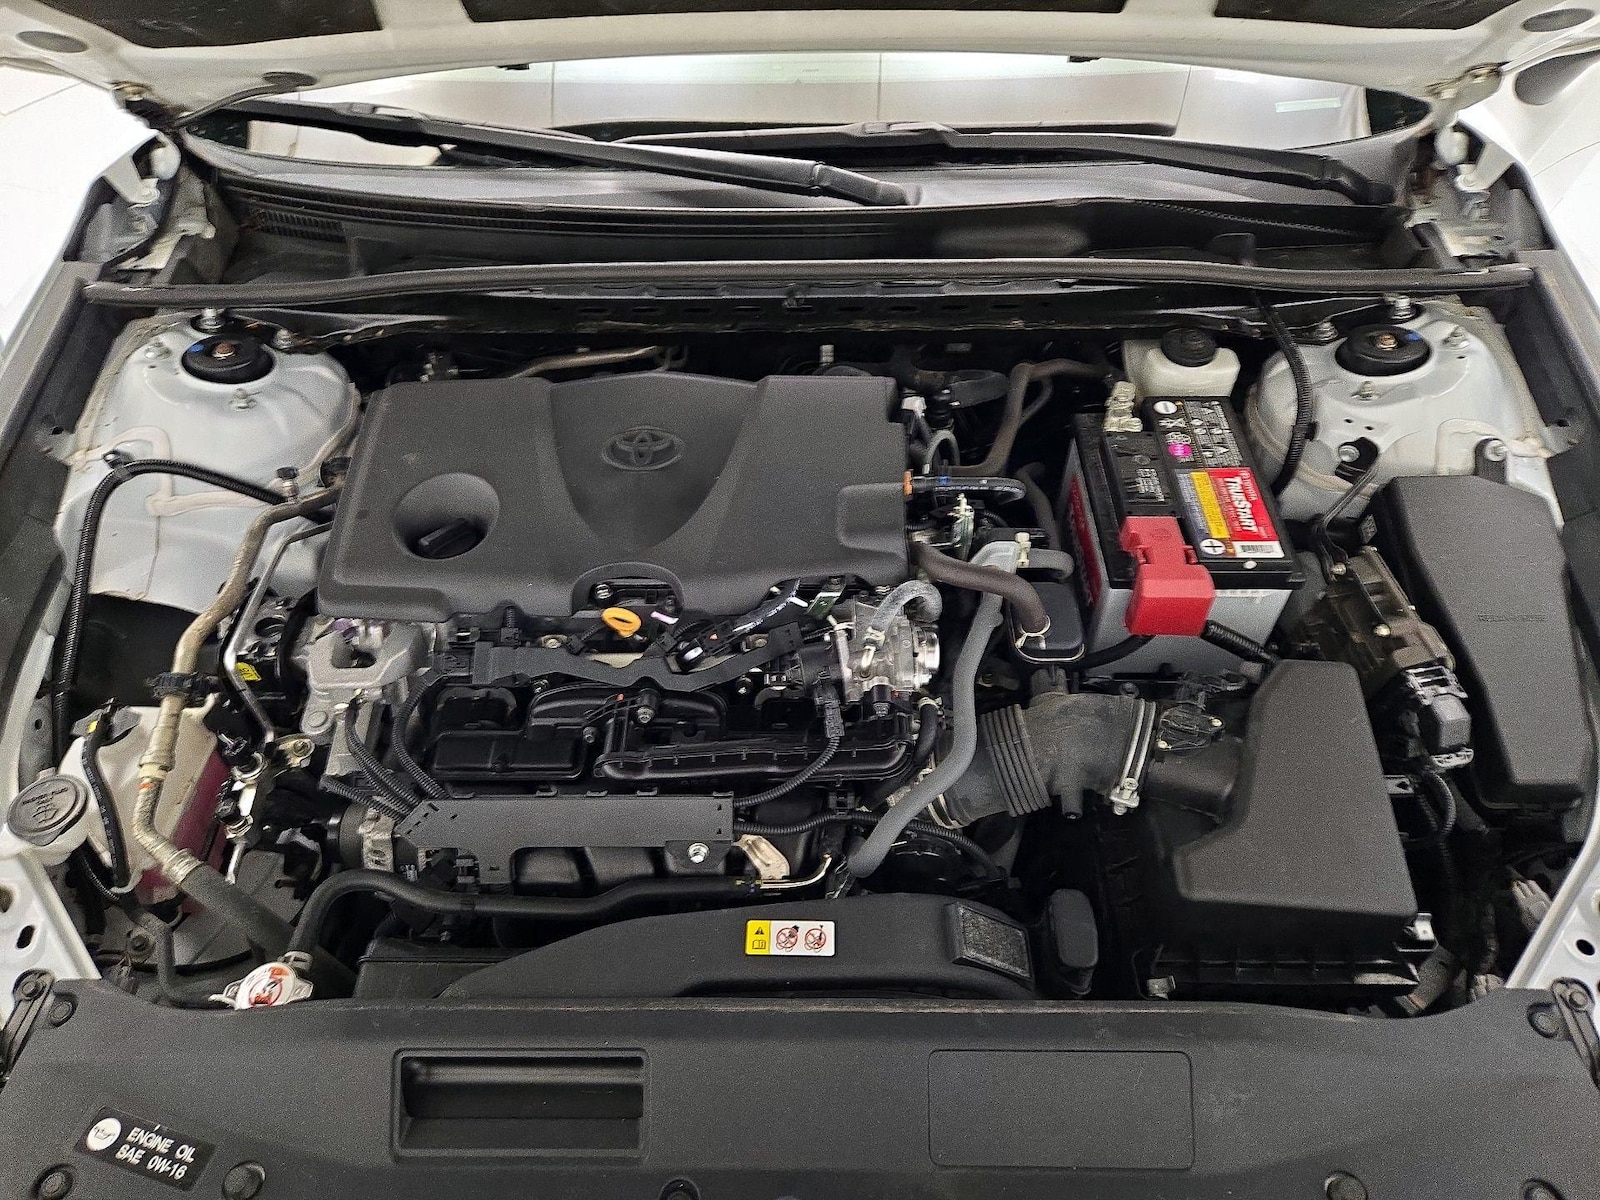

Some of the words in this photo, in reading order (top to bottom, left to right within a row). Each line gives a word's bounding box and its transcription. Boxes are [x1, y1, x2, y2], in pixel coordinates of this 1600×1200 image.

[1242, 478, 1258, 501] TOYOTA
[115, 1144, 146, 1165] SAE
[146, 1155, 188, 1180] 0W-16
[125, 1127, 175, 1154] ENGINE
[174, 1144, 196, 1163] OIL
